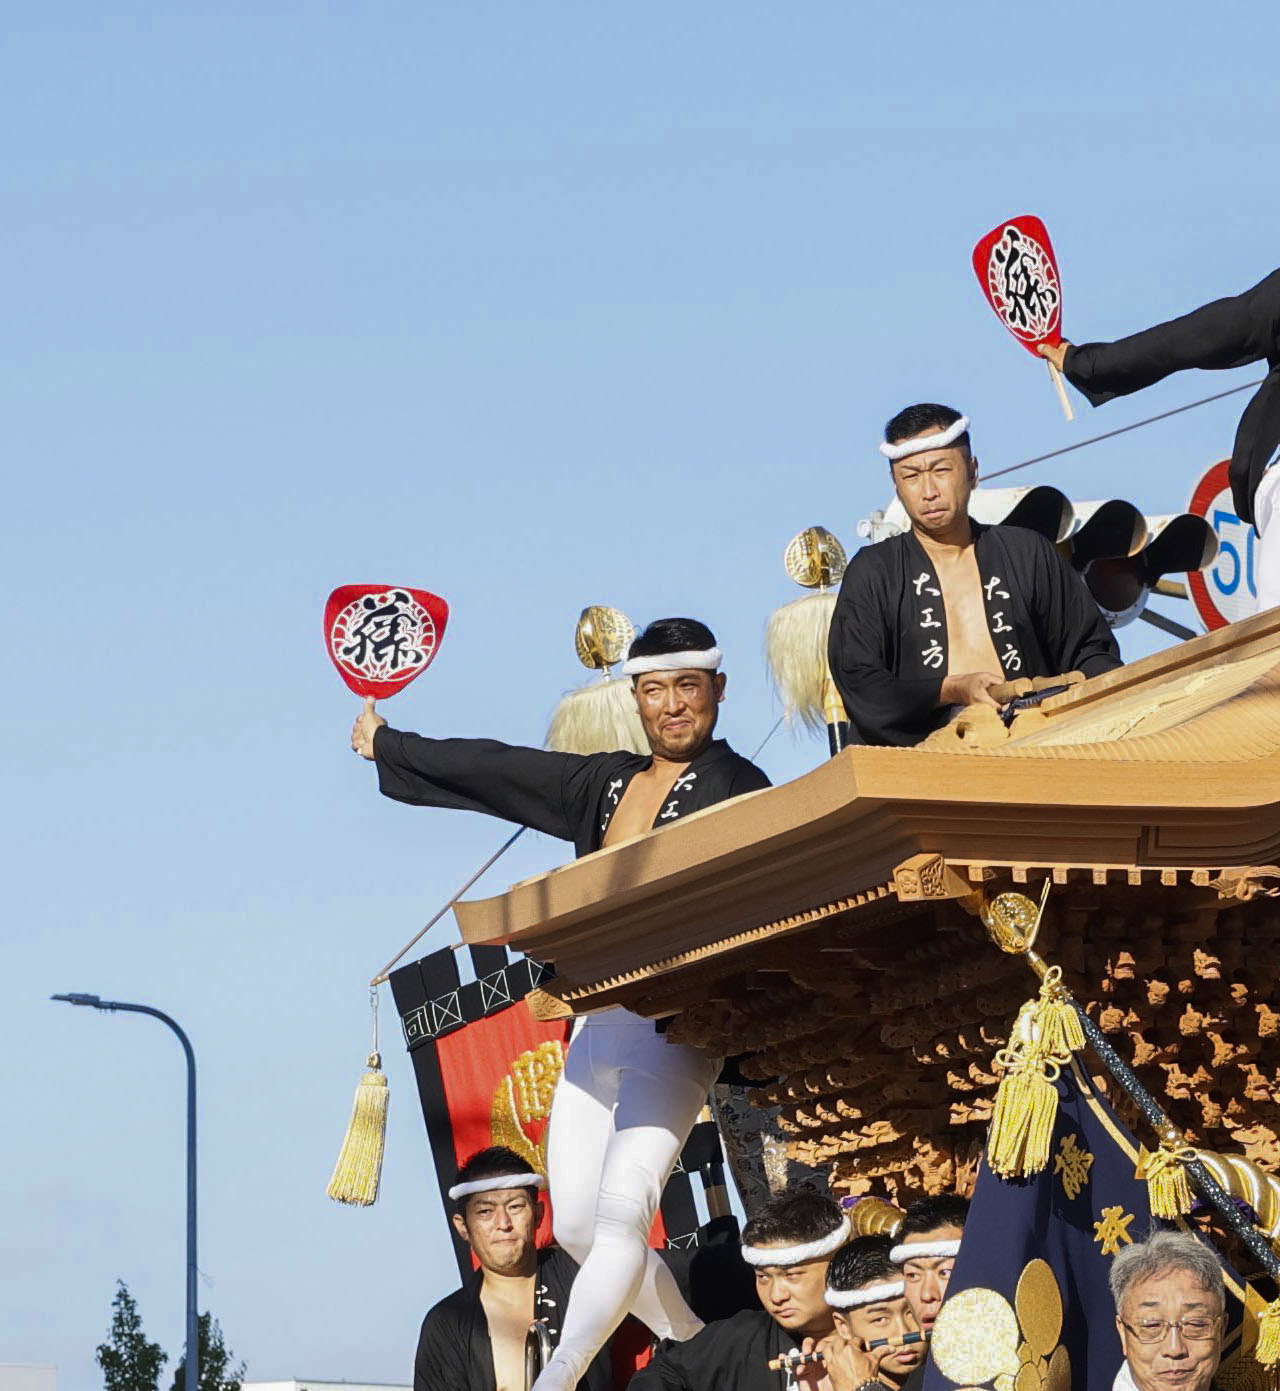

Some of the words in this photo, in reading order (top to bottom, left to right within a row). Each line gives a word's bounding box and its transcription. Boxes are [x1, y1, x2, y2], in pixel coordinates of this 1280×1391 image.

[913, 572, 944, 669] 大工方
[984, 576, 1023, 671] 大工方
